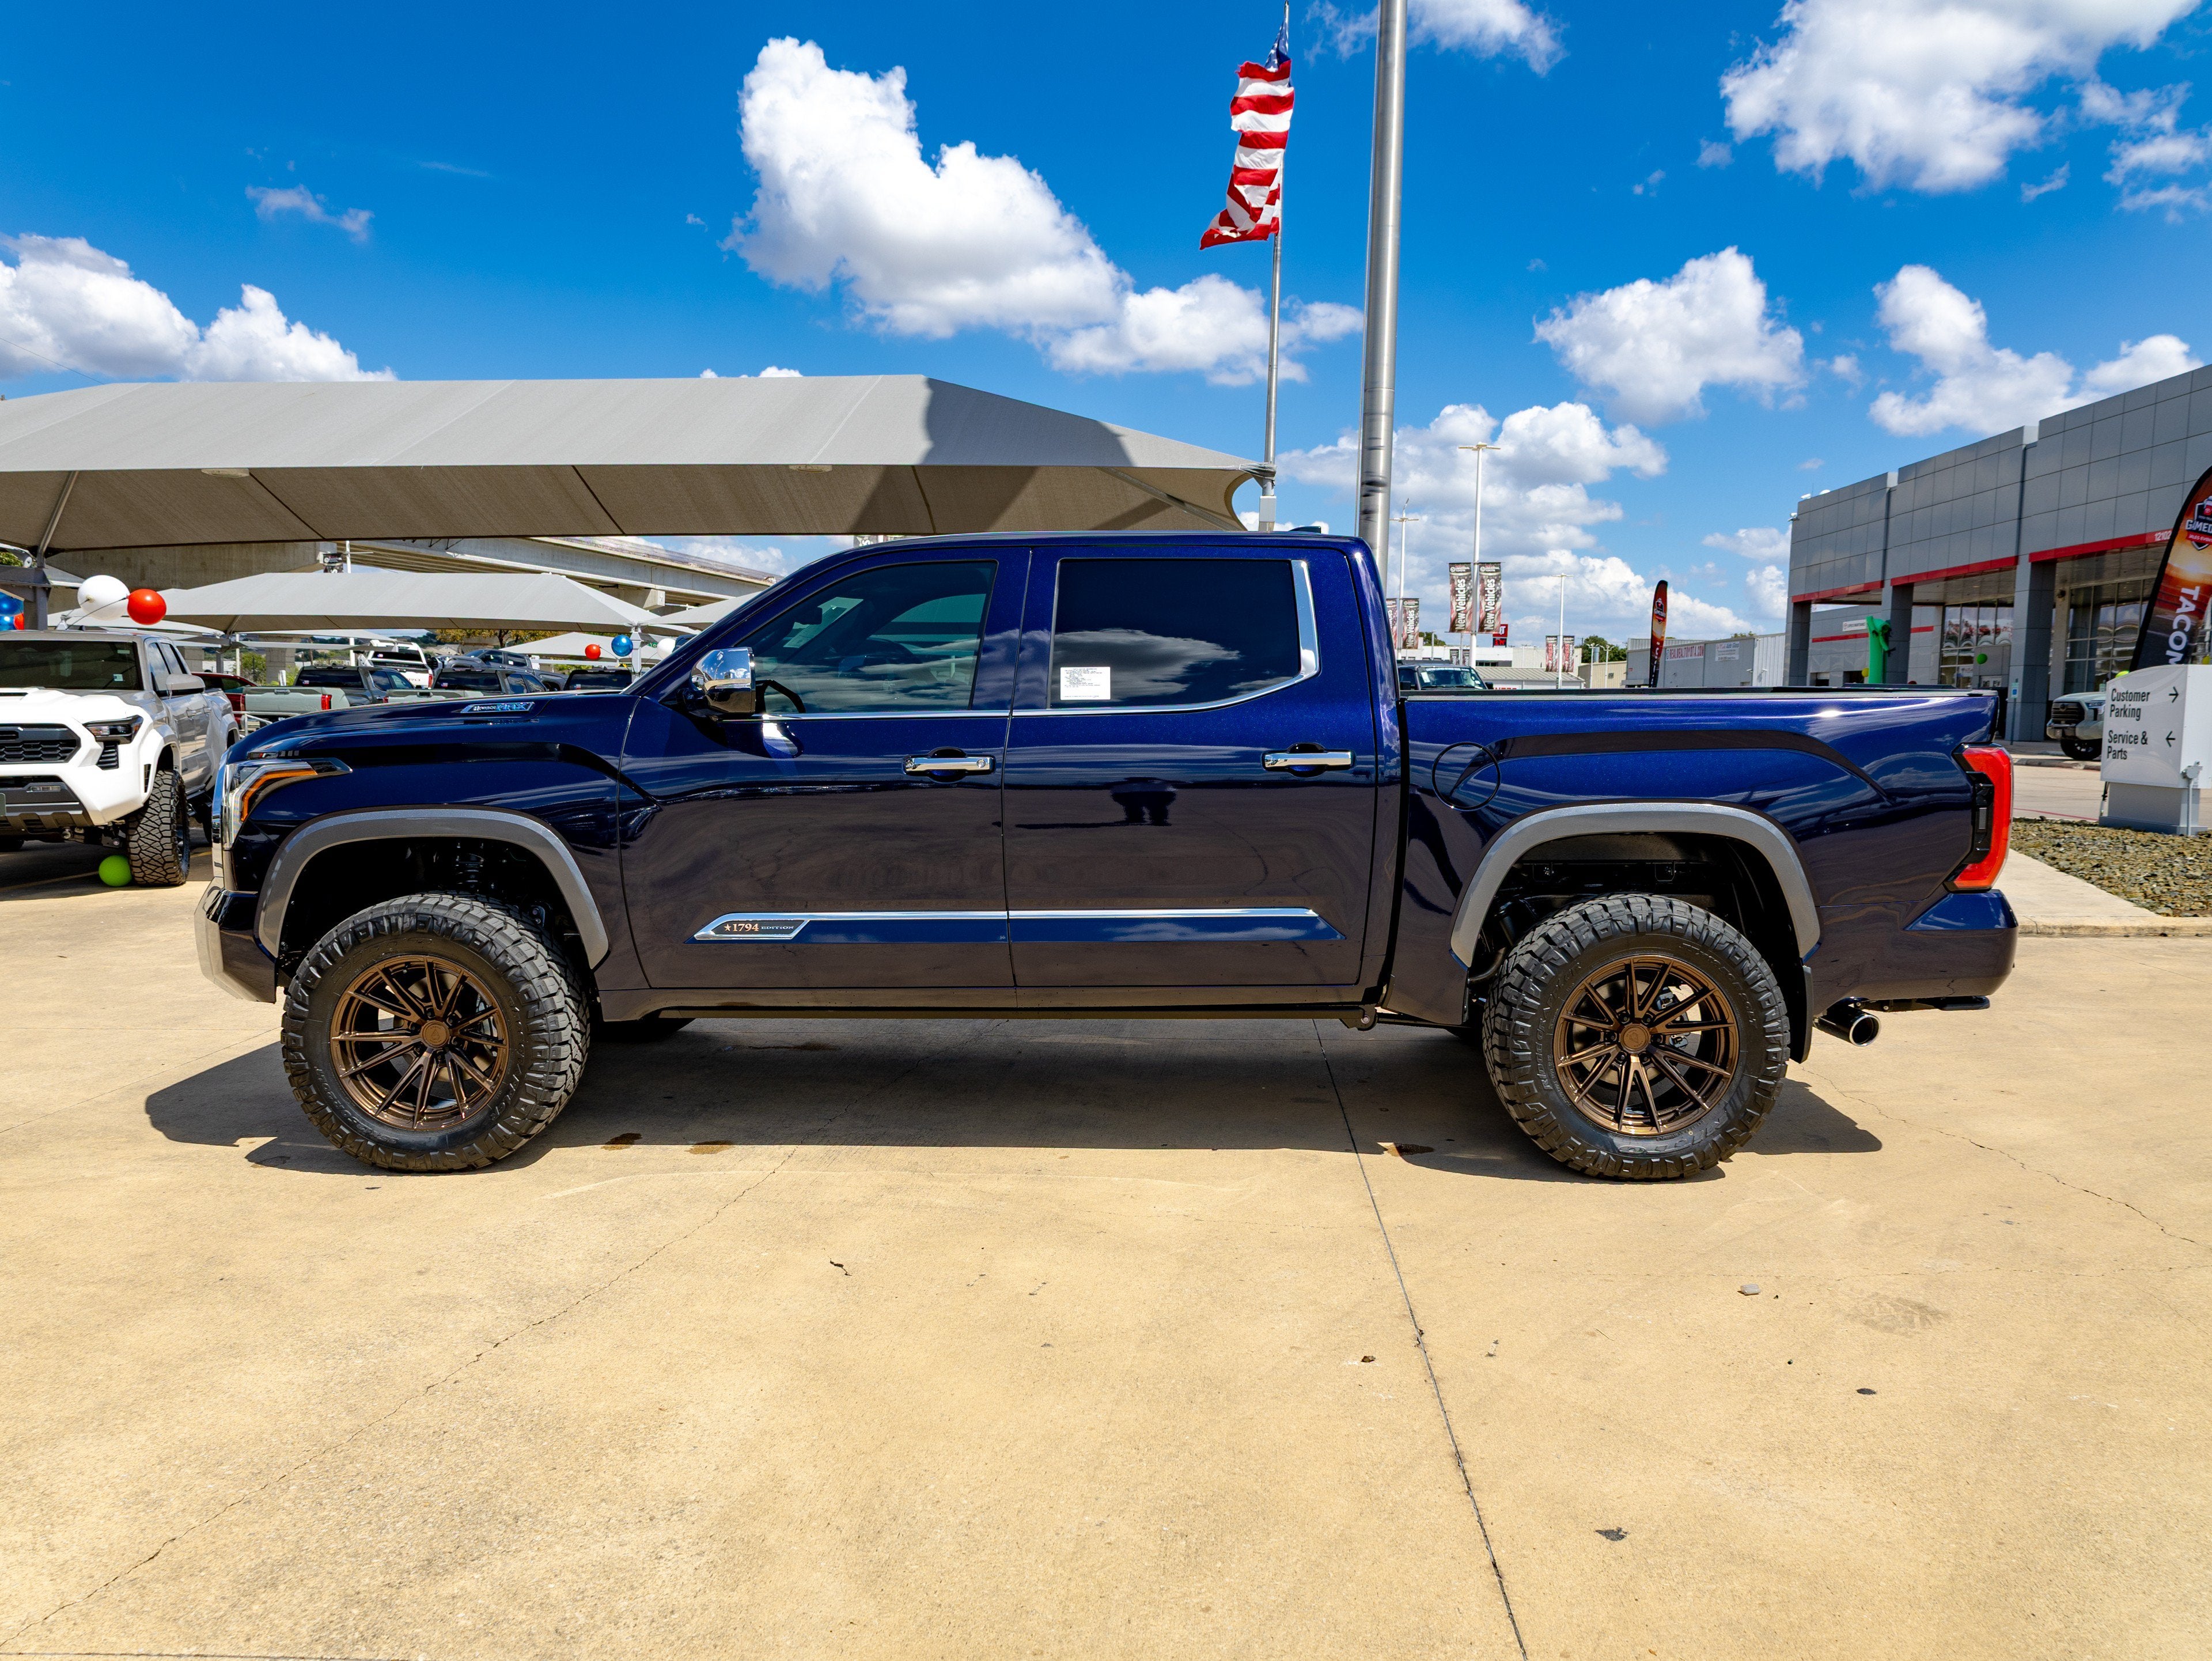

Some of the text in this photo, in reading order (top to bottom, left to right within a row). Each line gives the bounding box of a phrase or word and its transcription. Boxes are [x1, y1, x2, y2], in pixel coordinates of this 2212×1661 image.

[1455, 578, 1466, 611] Vehicles
[1484, 578, 1495, 612] Vehicles
[1407, 610, 1415, 634] Vehicles
[1455, 612, 1466, 630] New
[1484, 612, 1495, 630] New
[1406, 634, 1414, 647] New
[2111, 688, 2150, 702] Customer
[2109, 704, 2141, 721] Parking
[2108, 729, 2148, 745] Service &
[2107, 746, 2127, 760] Parts
[732, 923, 759, 932] 1794
